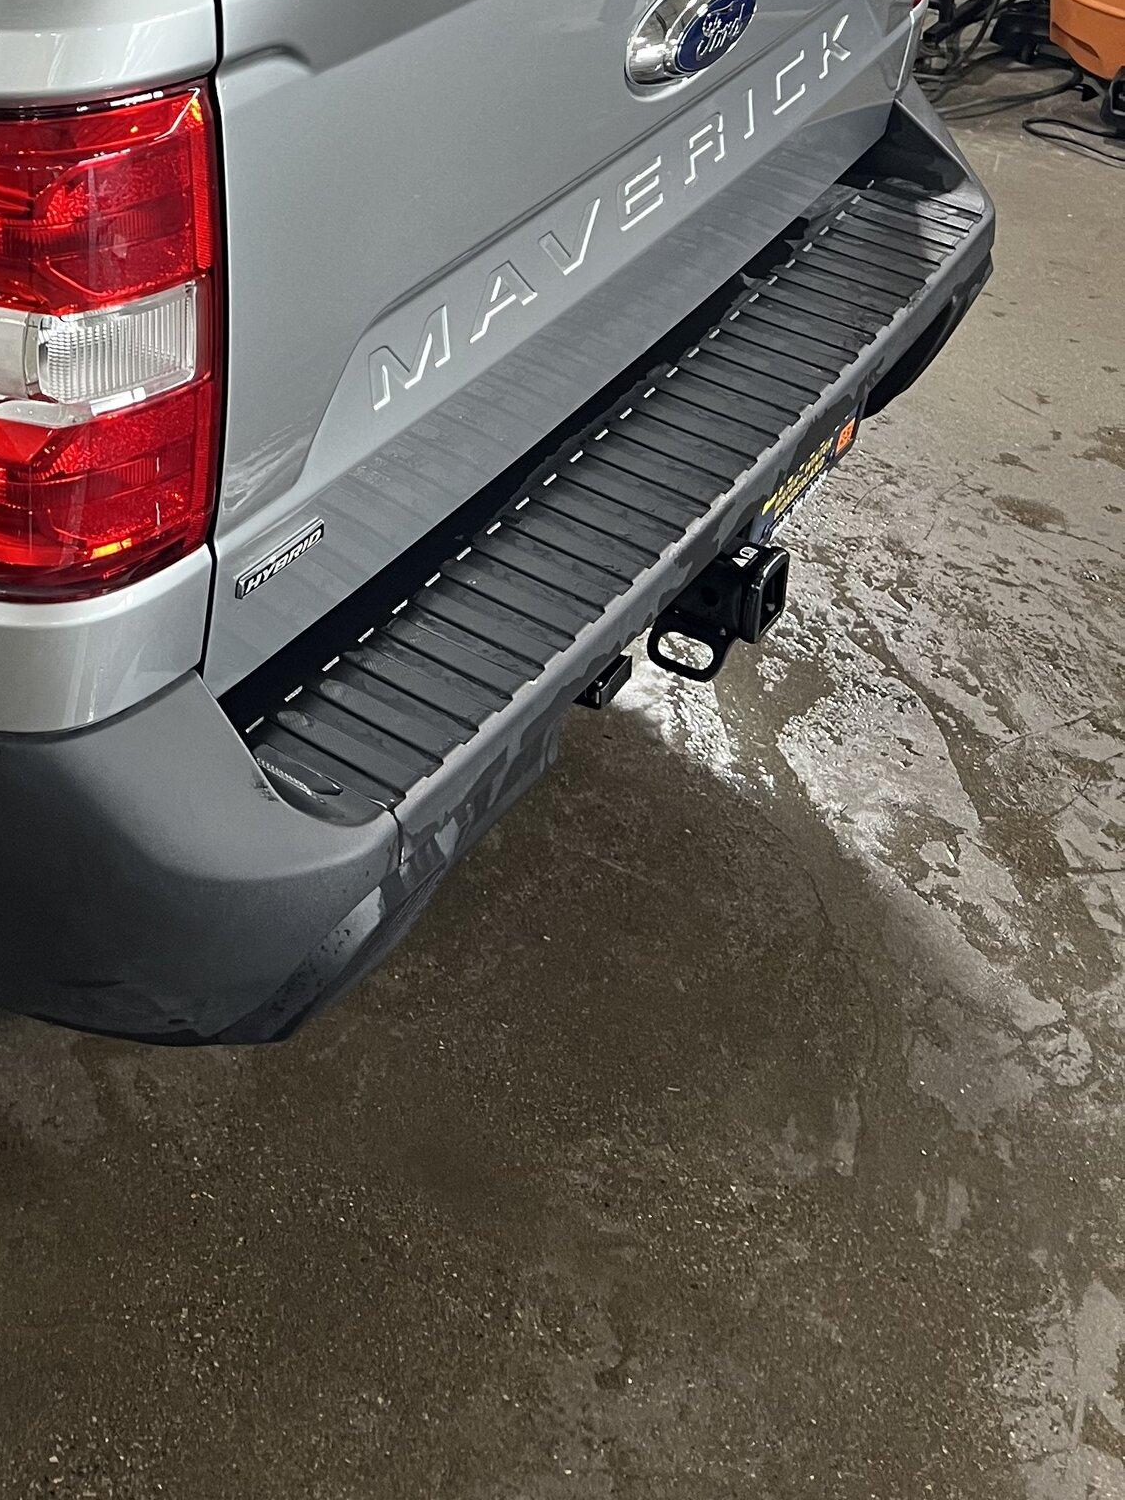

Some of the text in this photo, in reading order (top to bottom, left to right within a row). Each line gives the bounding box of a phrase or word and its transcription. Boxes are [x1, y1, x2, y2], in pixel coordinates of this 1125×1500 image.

[695, 1, 746, 61] Ford
[368, 13, 852, 412] MAVERICK
[245, 528, 323, 595] HYBRID
